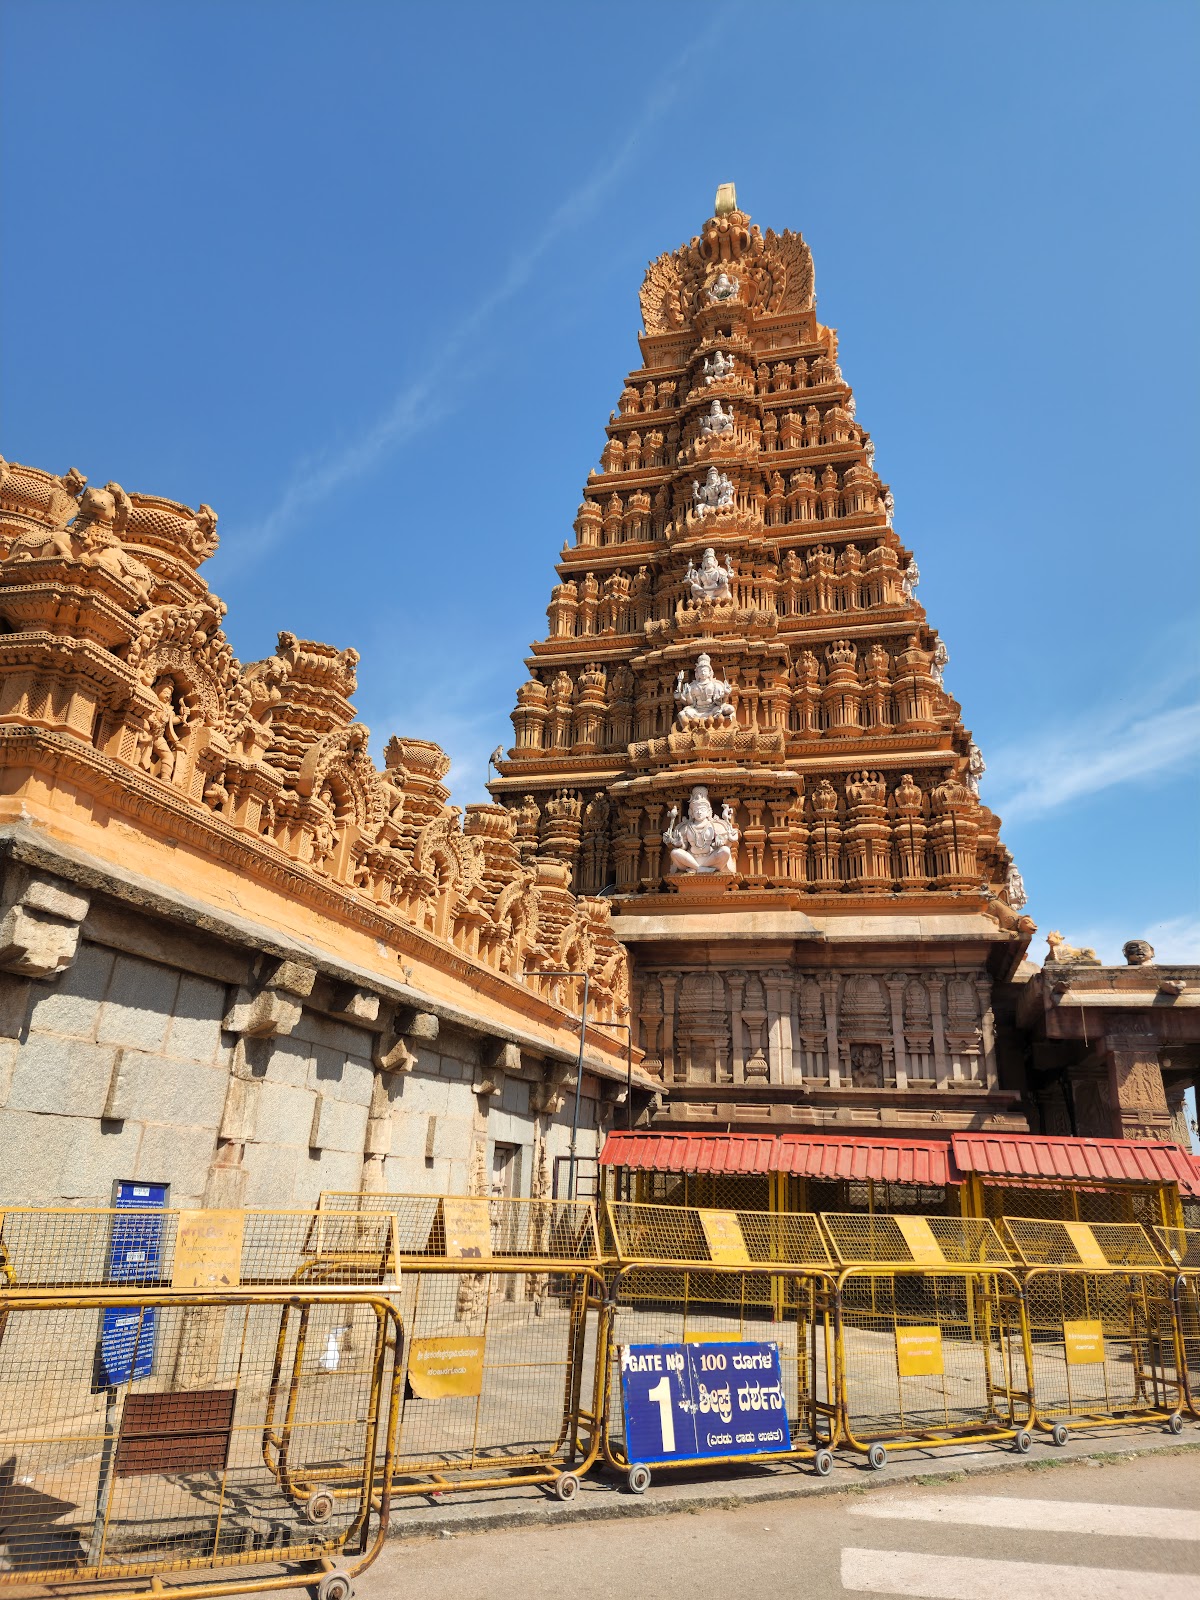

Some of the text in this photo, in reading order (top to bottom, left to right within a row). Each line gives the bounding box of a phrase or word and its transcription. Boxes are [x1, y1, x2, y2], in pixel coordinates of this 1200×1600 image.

[629, 1353, 685, 1372] GATE NO
[700, 1354, 727, 1371] 100
[649, 1377, 676, 1452] 1
[699, 1379, 782, 1424] ಶೀಘ್ರ ದರ್ಶನ
